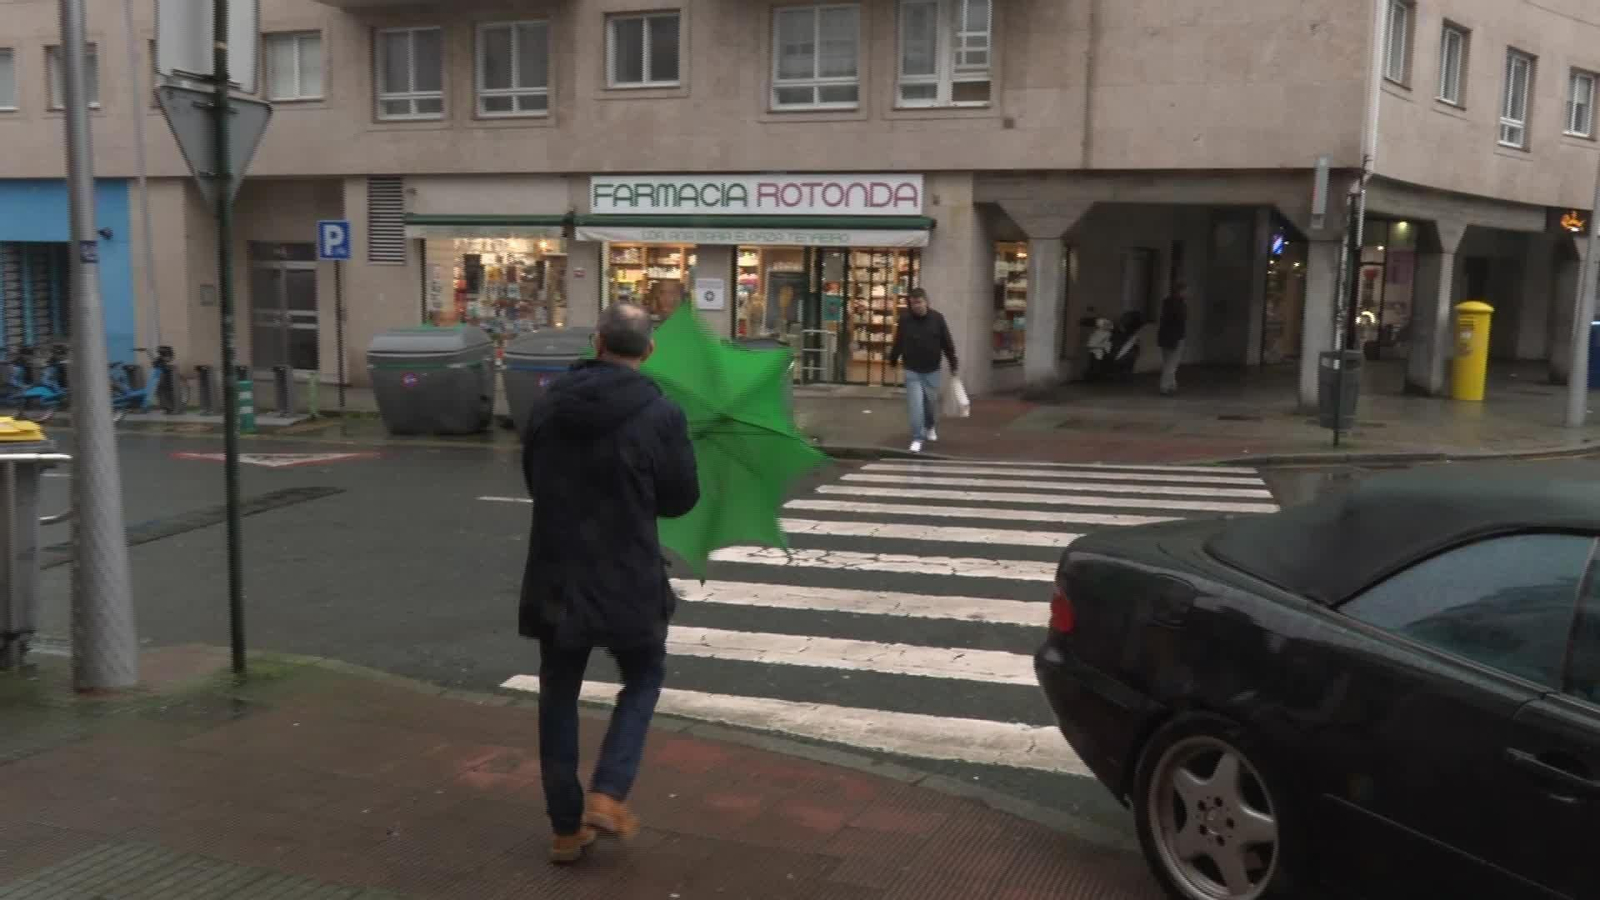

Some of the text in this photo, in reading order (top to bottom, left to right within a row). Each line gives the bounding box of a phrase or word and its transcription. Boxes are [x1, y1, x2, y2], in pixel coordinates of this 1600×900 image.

[593, 182, 918, 207] FARMACIA ROTONDA
[324, 225, 344, 256] P
